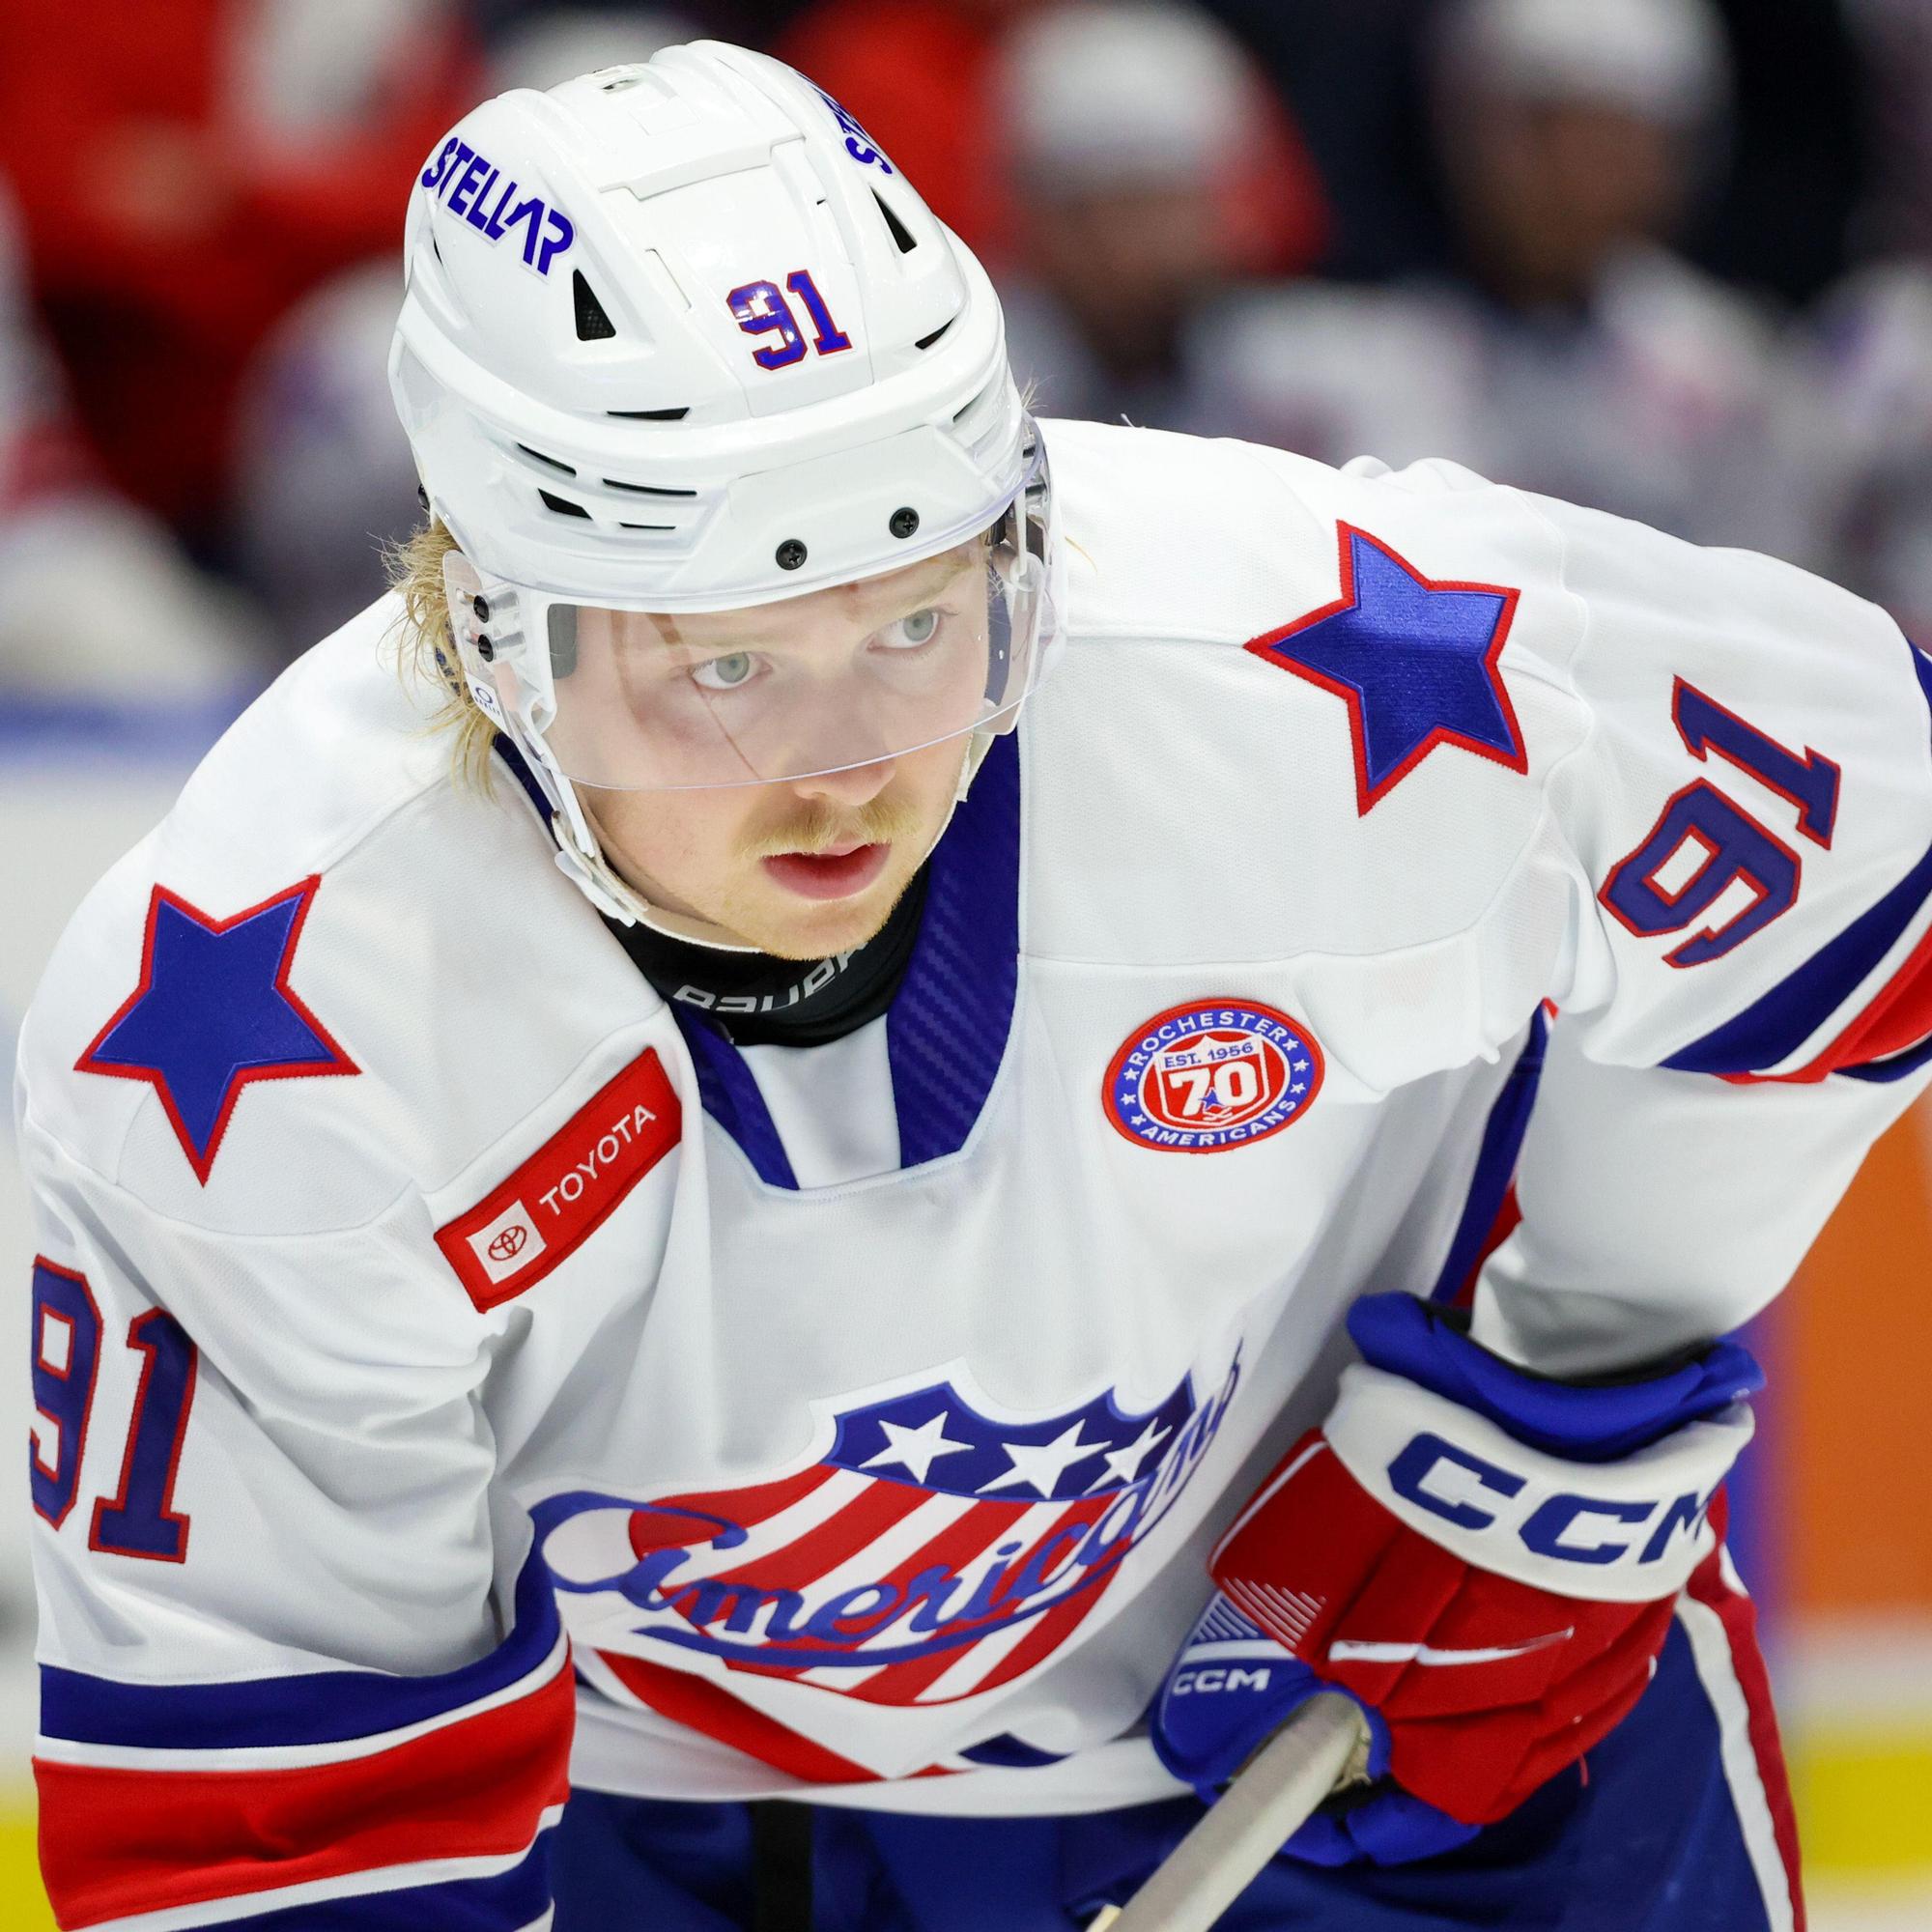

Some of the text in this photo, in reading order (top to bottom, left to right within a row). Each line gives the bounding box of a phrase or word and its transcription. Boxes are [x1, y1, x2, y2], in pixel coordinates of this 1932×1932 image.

[421, 137, 575, 276] STELLAR
[726, 269, 853, 372] 91
[1597, 673, 1841, 970] 91
[1128, 1010, 1289, 1066] ROCHESTER
[1164, 1041, 1254, 1069] EST. 1956
[1168, 1060, 1259, 1118] 70
[539, 1103, 657, 1217] TOYOTA
[1140, 1098, 1297, 1147] AMERICANS
[29, 1253, 199, 1565] 91
[1387, 1431, 1710, 1566] CCM
[1172, 1667, 1271, 1696] CCM
